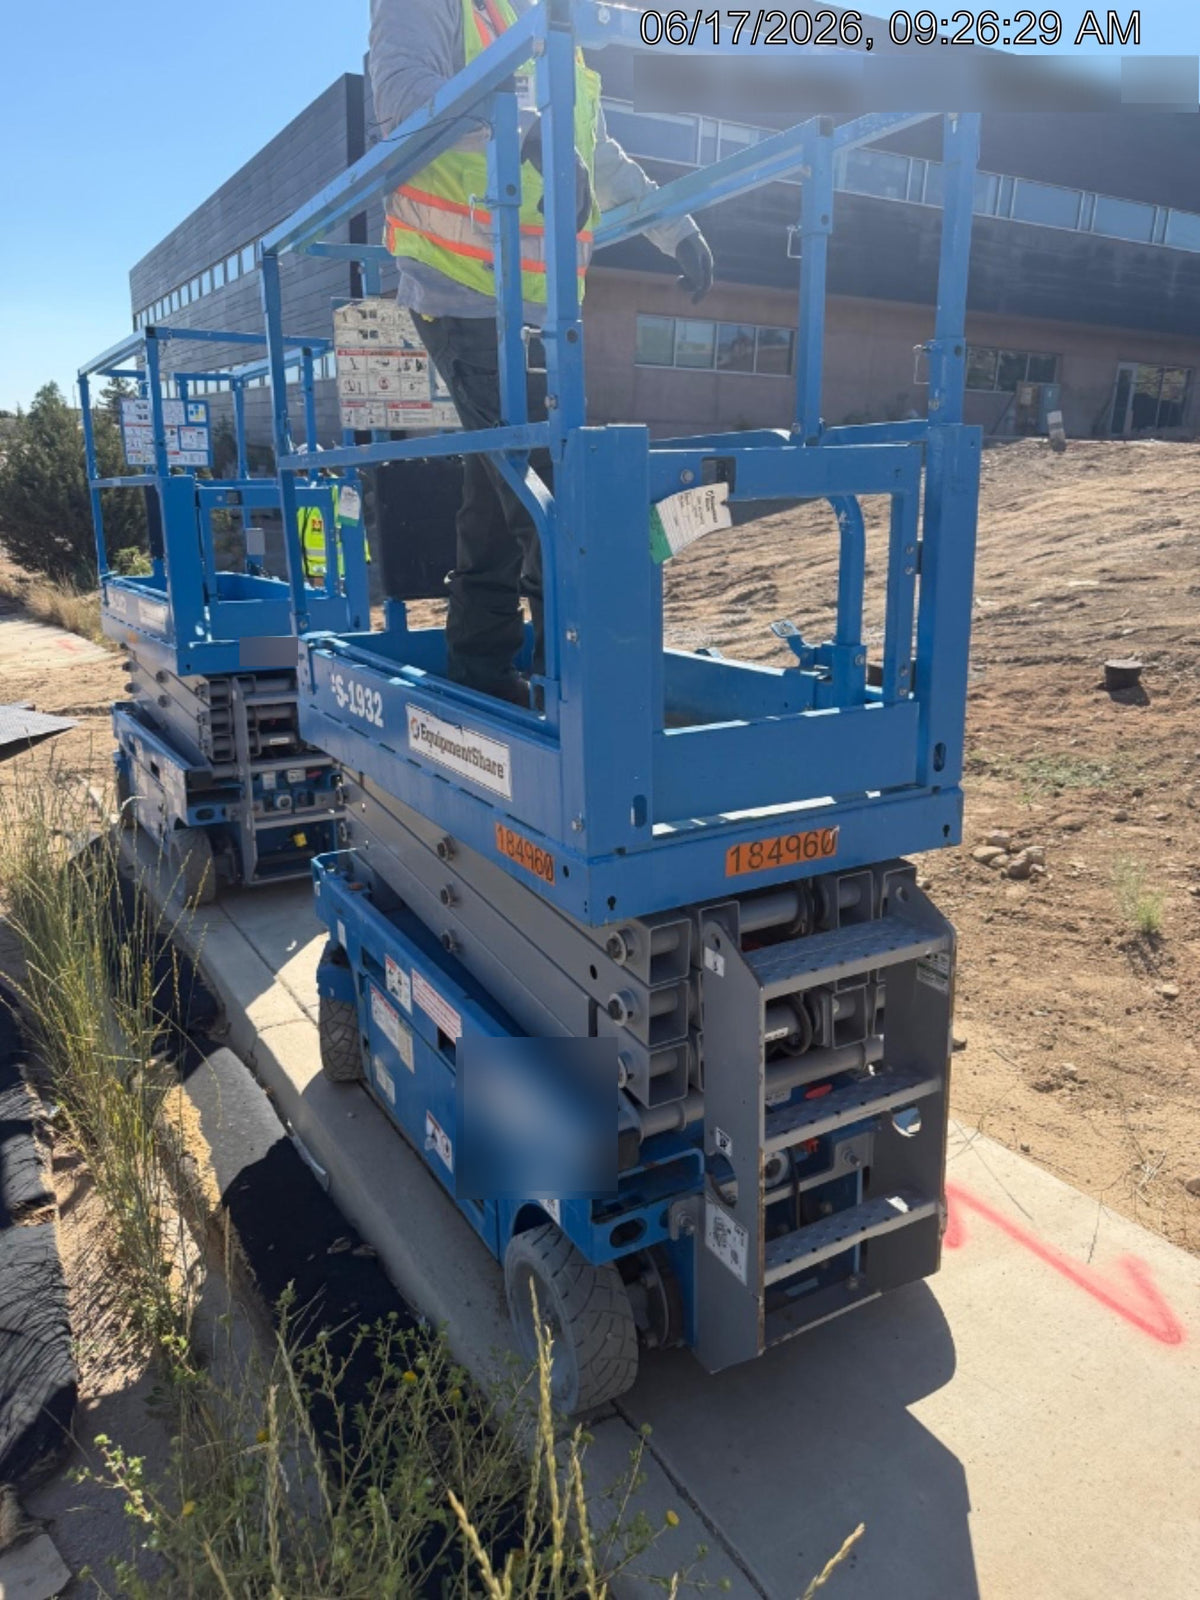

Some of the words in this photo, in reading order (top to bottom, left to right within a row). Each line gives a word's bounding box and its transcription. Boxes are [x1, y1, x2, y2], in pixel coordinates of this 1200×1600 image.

[420, 722, 505, 780] EquipmentShare
[497, 824, 554, 882] 184960
[729, 827, 837, 874] 184960
